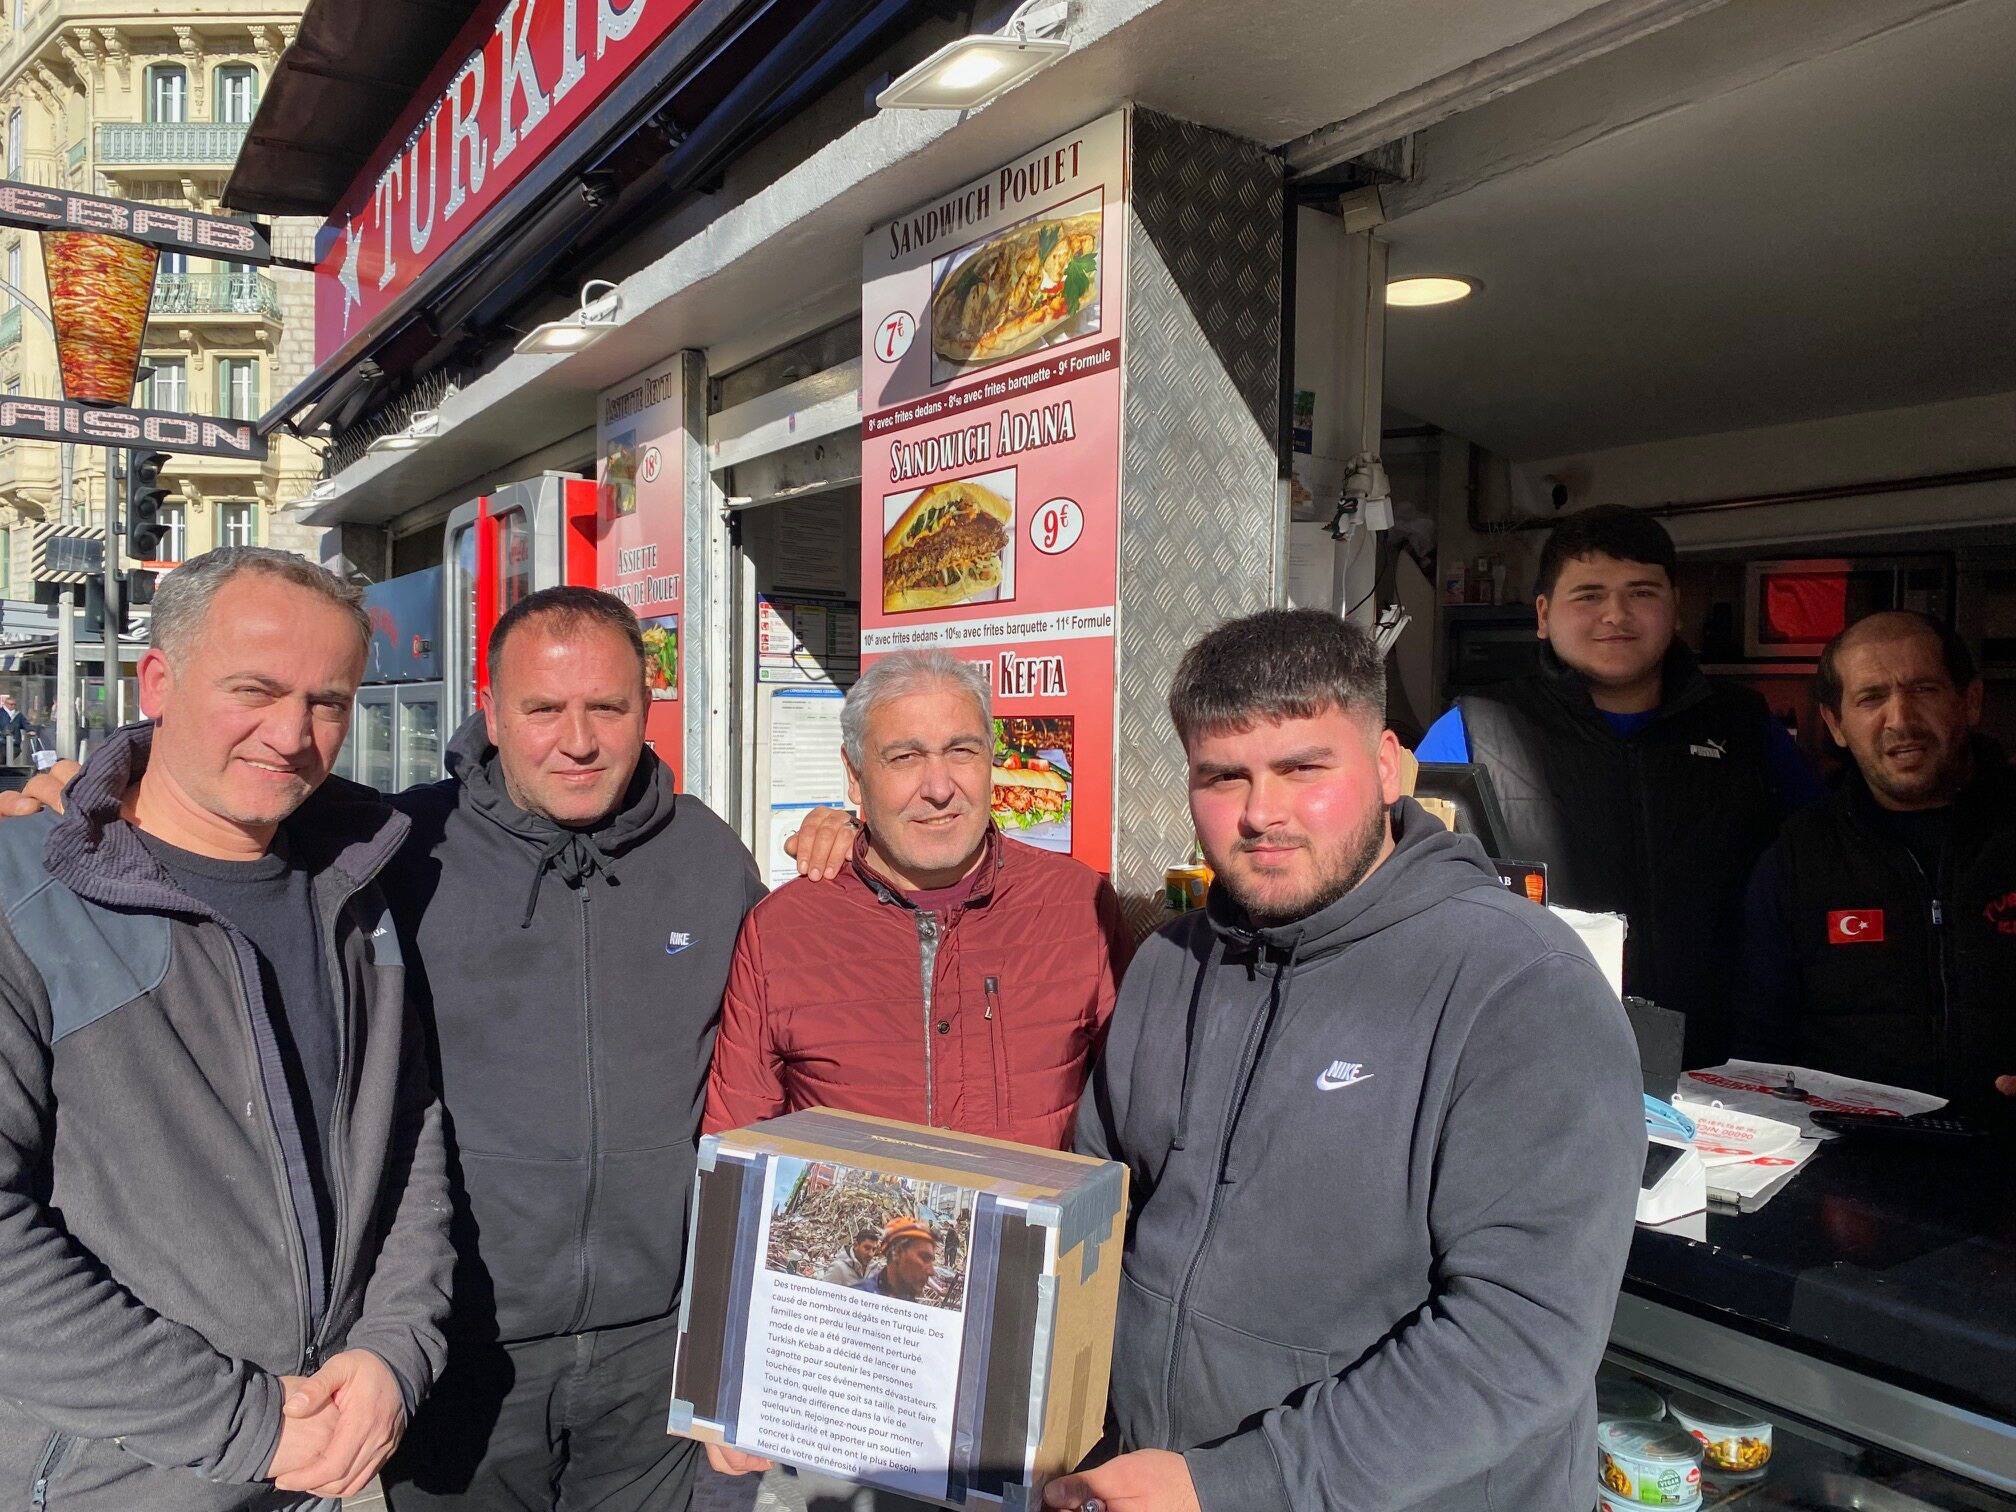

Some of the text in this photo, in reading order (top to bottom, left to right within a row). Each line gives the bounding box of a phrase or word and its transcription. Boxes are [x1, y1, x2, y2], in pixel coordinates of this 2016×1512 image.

[890, 139, 1083, 260] SANDWICH POULET
[886, 316, 905, 357] 7€
[876, 416, 893, 430] avec
[895, 410, 913, 424] frites
[915, 401, 942, 418] dedans
[963, 389, 983, 404] avec
[984, 382, 1006, 398] frites
[1008, 369, 1050, 390] barquette
[1070, 348, 1111, 372] Formule
[890, 400, 1076, 483] SANDWICH ADANA
[1044, 504, 1070, 548] 9€
[617, 543, 657, 576] ASSIETTE
[647, 574, 680, 604] POULET
[875, 634, 891, 645] avec
[892, 632, 910, 644] frites
[912, 629, 938, 642] dedans
[963, 626, 981, 638] avec
[984, 623, 1004, 636] frites
[1006, 619, 1047, 636] barquette
[1072, 613, 1111, 629] Formule
[999, 651, 1068, 697] KEFTA
[670, 932, 690, 946] NIKE
[1326, 1060, 1362, 1080] NIKE
[773, 1278, 928, 1322] Des tremblements de terre récents ont
[796, 1297, 807, 1306] de
[808, 1301, 850, 1317] nombreux
[880, 1319, 890, 1327] en
[928, 1328, 944, 1339] Des
[768, 1320, 792, 1331] mode
[793, 1324, 804, 1334] de
[805, 1327, 818, 1336] vie
[826, 1331, 840, 1341] été
[841, 1336, 884, 1353] gravement
[770, 1305, 920, 1348] familles ont perdu leur maison et leur
[765, 1359, 800, 1375] touchées
[802, 1369, 816, 1379] par
[817, 1372, 832, 1382] ces
[766, 1346, 913, 1390] cagnotte pour soutenir les personnes
[768, 1332, 796, 1346] Turkish
[798, 1339, 824, 1352] Kebab
[833, 1347, 861, 1360] décidé
[862, 1354, 873, 1364] de
[874, 1357, 899, 1370] lancer
[900, 1366, 916, 1375] une
[763, 1386, 778, 1396] une
[779, 1391, 807, 1404] grande
[851, 1407, 871, 1420] dans
[873, 1412, 880, 1423] la
[882, 1416, 894, 1425] vie
[895, 1419, 906, 1429] de
[764, 1372, 782, 1384] Tout
[801, 1383, 827, 1396] quelle
[828, 1389, 845, 1399] que
[846, 1392, 862, 1403] soit
[863, 1398, 872, 1407] sa
[897, 1407, 915, 1418] peut
[917, 1411, 936, 1424] faire
[758, 1426, 788, 1440] concret
[796, 1437, 815, 1448] ceux
[816, 1441, 830, 1453] qui
[832, 1446, 843, 1455] en
[843, 1449, 858, 1459] ont
[859, 1451, 867, 1461] le
[869, 1455, 887, 1466] plus
[760, 1413, 911, 1458] votre solidarité et apporter un soutien
[804, 1410, 866, 1432] Rejoignez-nous
[868, 1427, 888, 1437] pour
[890, 1433, 923, 1447] montrer
[757, 1438, 779, 1451] Merci
[780, 1445, 790, 1455] de
[792, 1448, 812, 1461] votre
[814, 1455, 856, 1472] générosité
